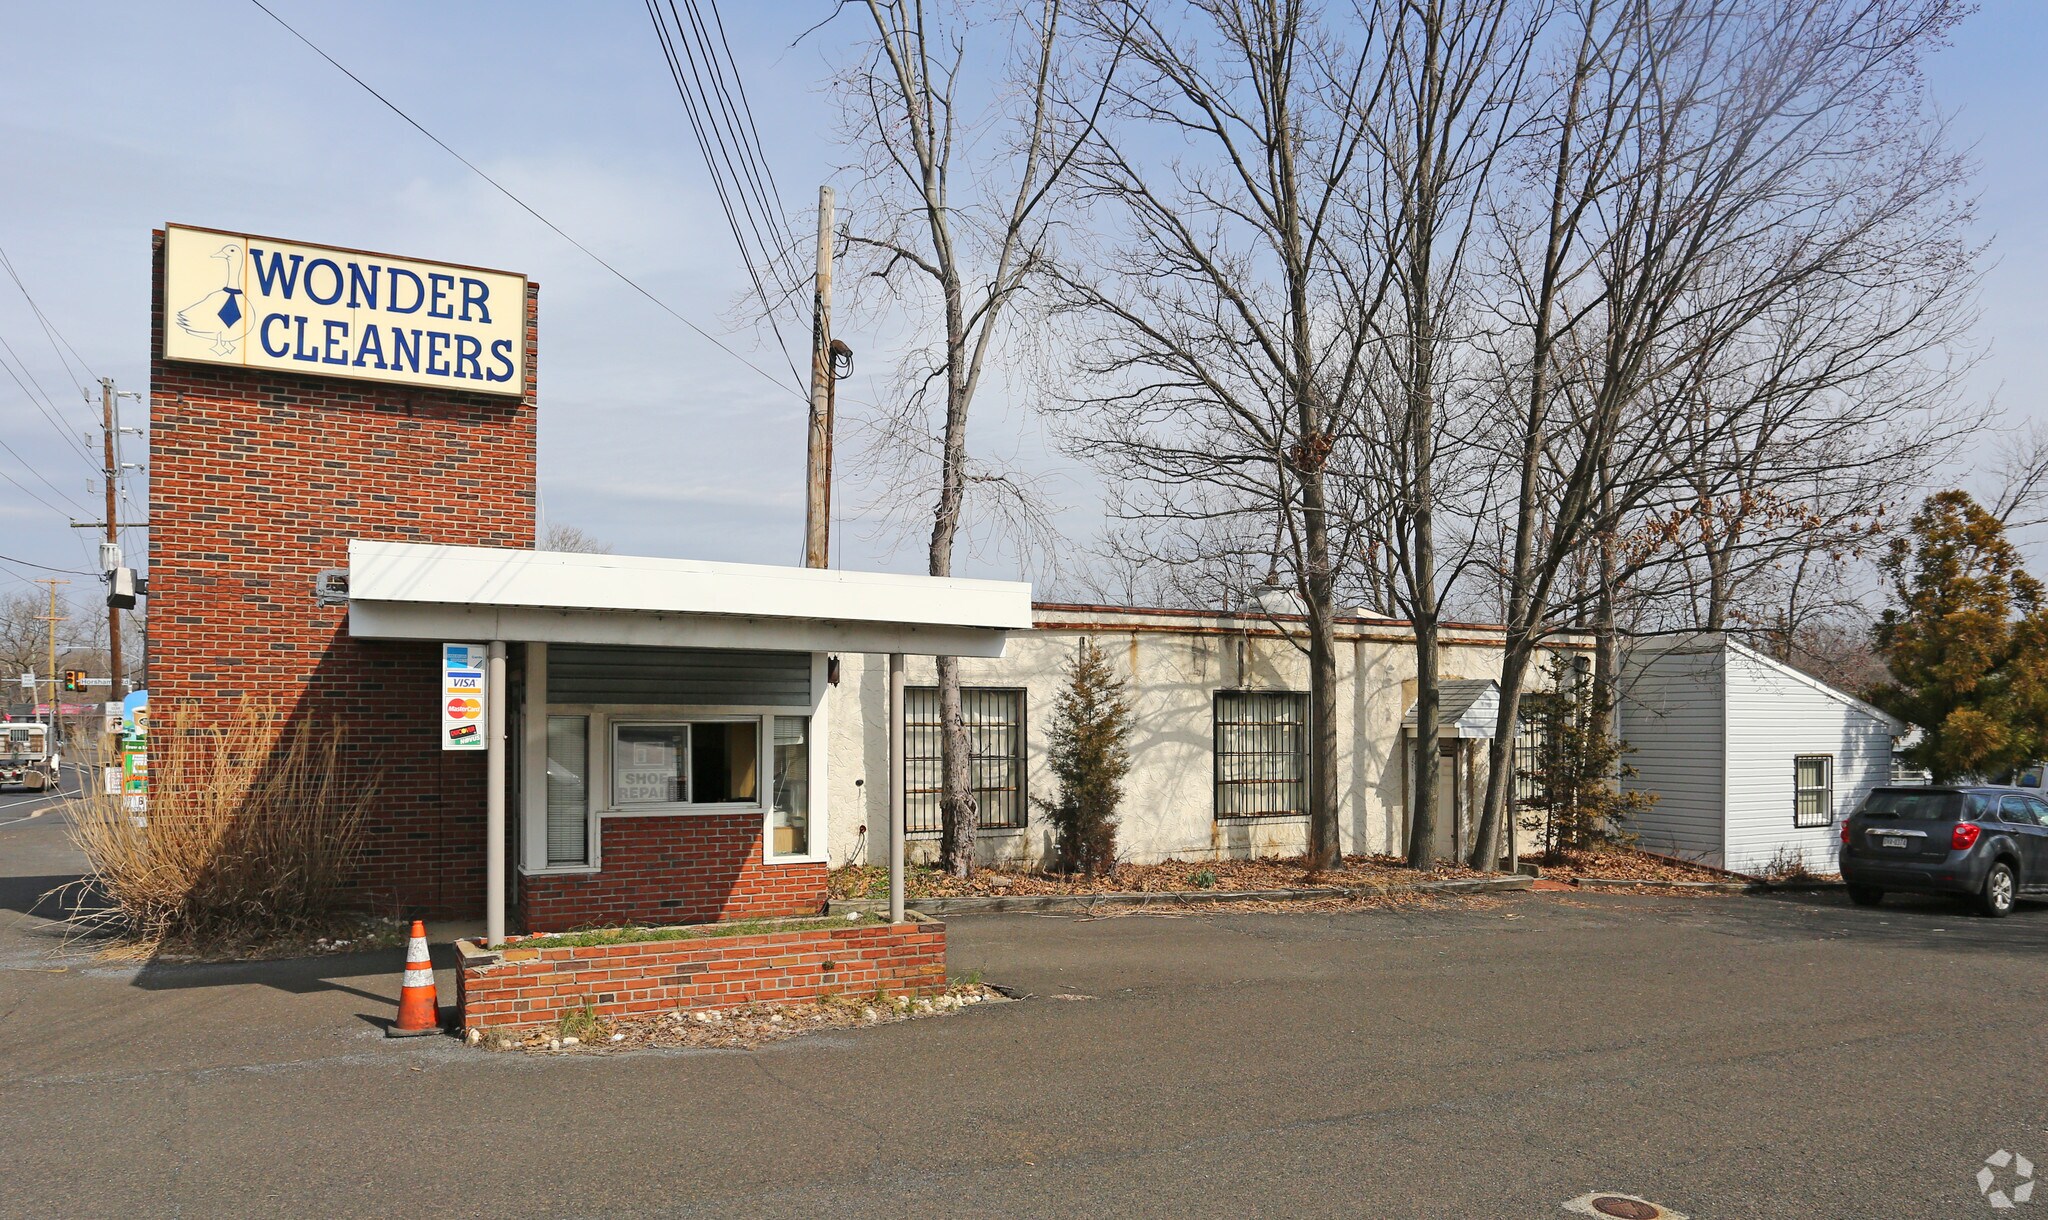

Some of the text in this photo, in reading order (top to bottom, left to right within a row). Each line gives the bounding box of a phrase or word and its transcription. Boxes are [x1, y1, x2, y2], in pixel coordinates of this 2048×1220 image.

[249, 248, 492, 324] WONDER
[260, 312, 515, 383] CLEANERS
[453, 678, 476, 688] VISA
[460, 735, 481, 745] NOVUS
[625, 772, 668, 785] SHOE
[618, 786, 667, 799] REPAI
